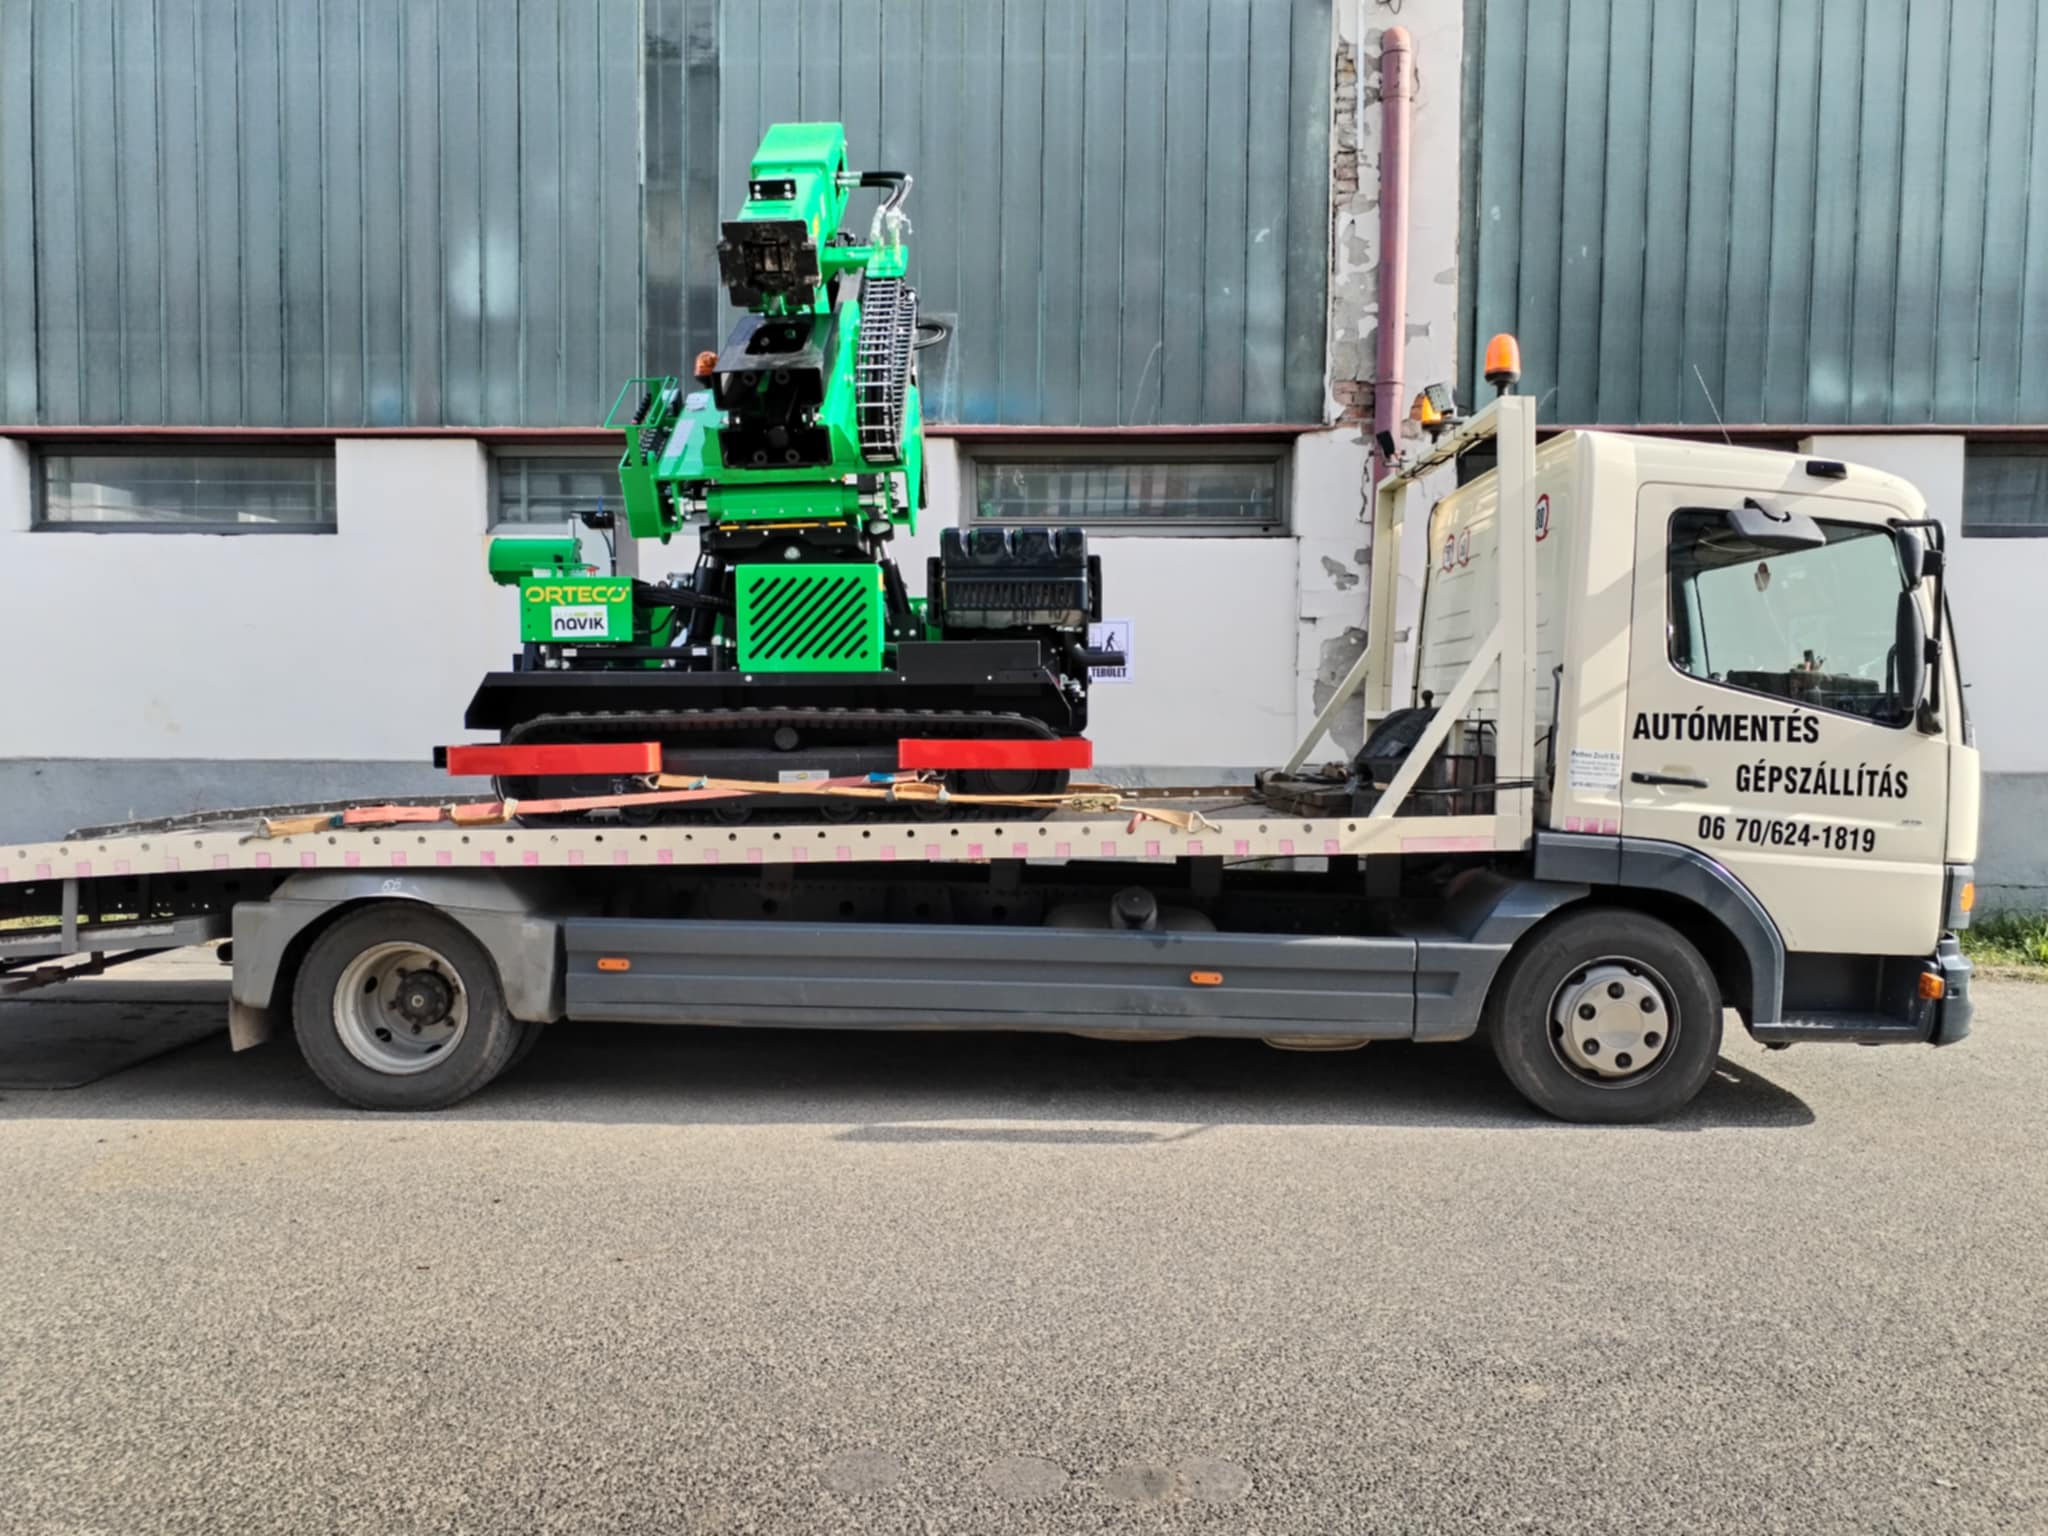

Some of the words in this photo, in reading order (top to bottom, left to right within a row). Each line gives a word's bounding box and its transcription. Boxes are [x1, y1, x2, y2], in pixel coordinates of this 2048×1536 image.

[525, 586, 630, 606] ORTECO
[1632, 706, 1819, 743] AUTÓMENTÉS
[1736, 759, 1909, 798] GÉPSZÁLLÍTÁS
[1698, 815, 1725, 841] 06
[1735, 818, 1876, 853] 70/624-1819
